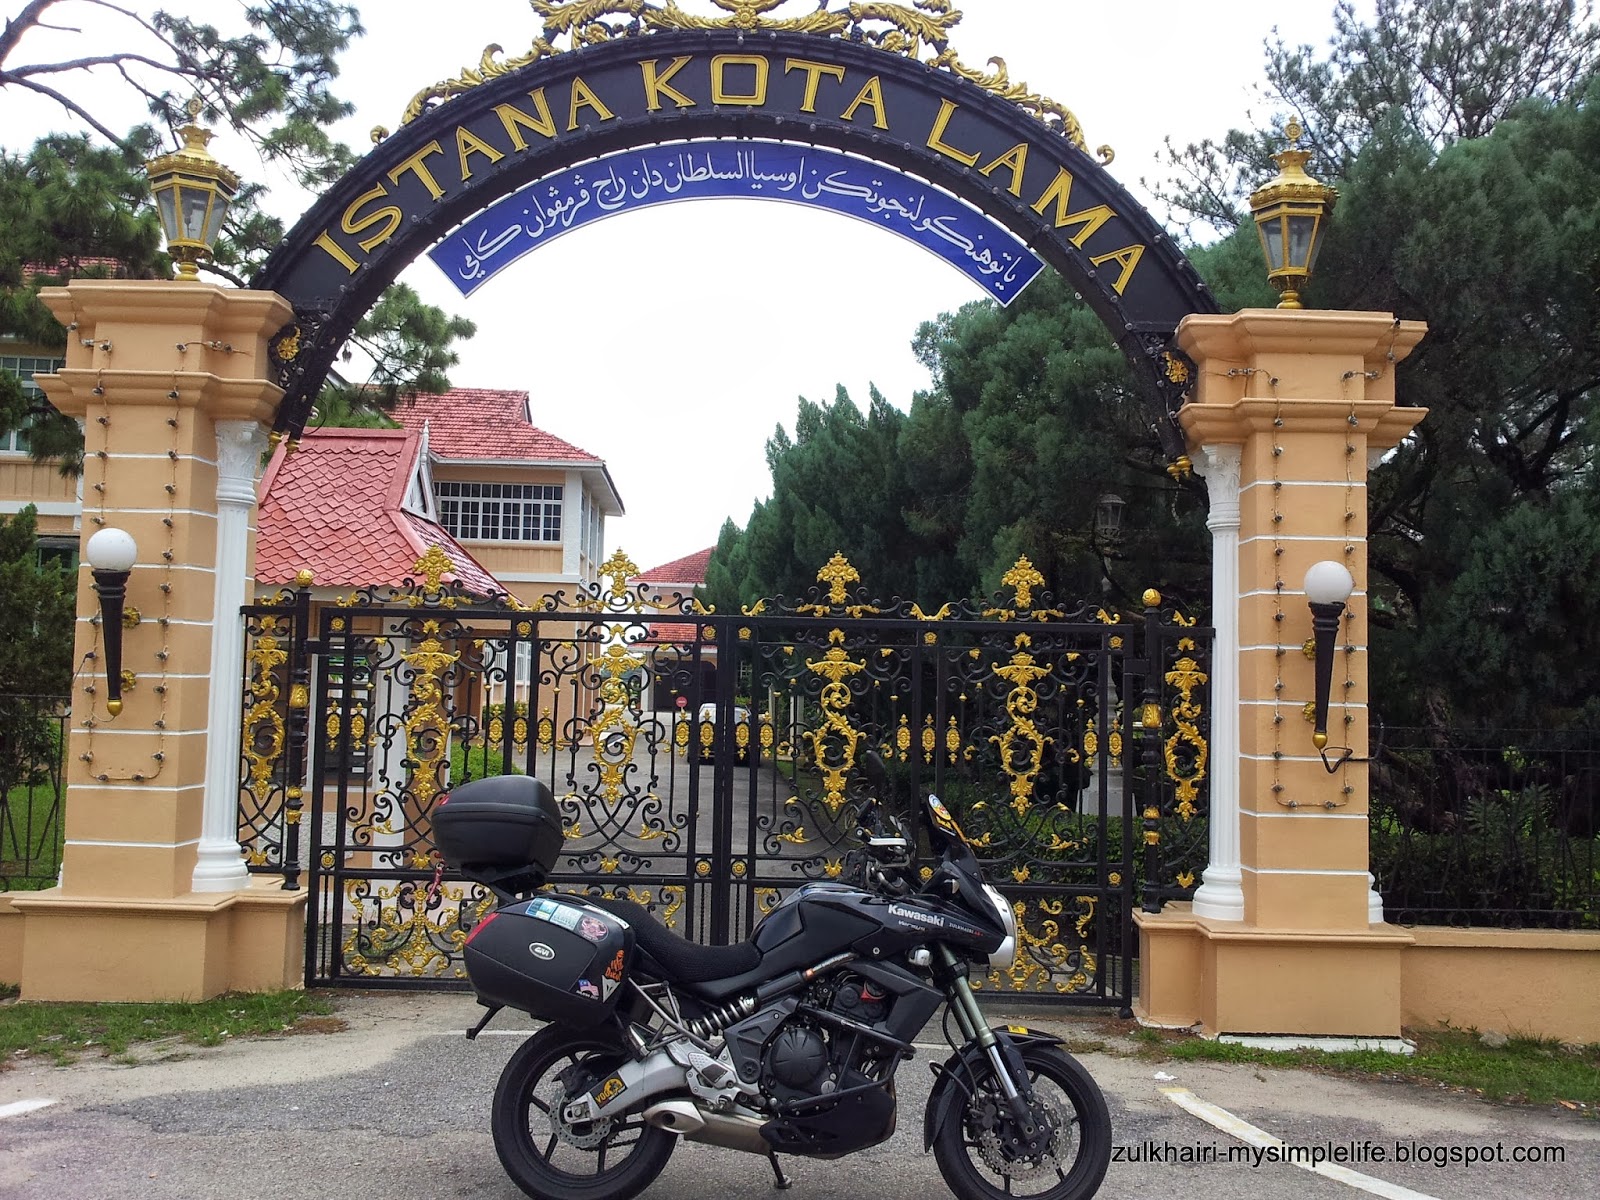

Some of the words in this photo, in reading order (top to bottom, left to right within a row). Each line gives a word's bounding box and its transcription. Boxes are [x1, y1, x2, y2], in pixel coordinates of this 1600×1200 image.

[313, 76, 614, 275] ISTANA
[638, 54, 889, 130] KOTA
[926, 98, 1145, 296] LAMA
[888, 904, 945, 928] Kawasaki
